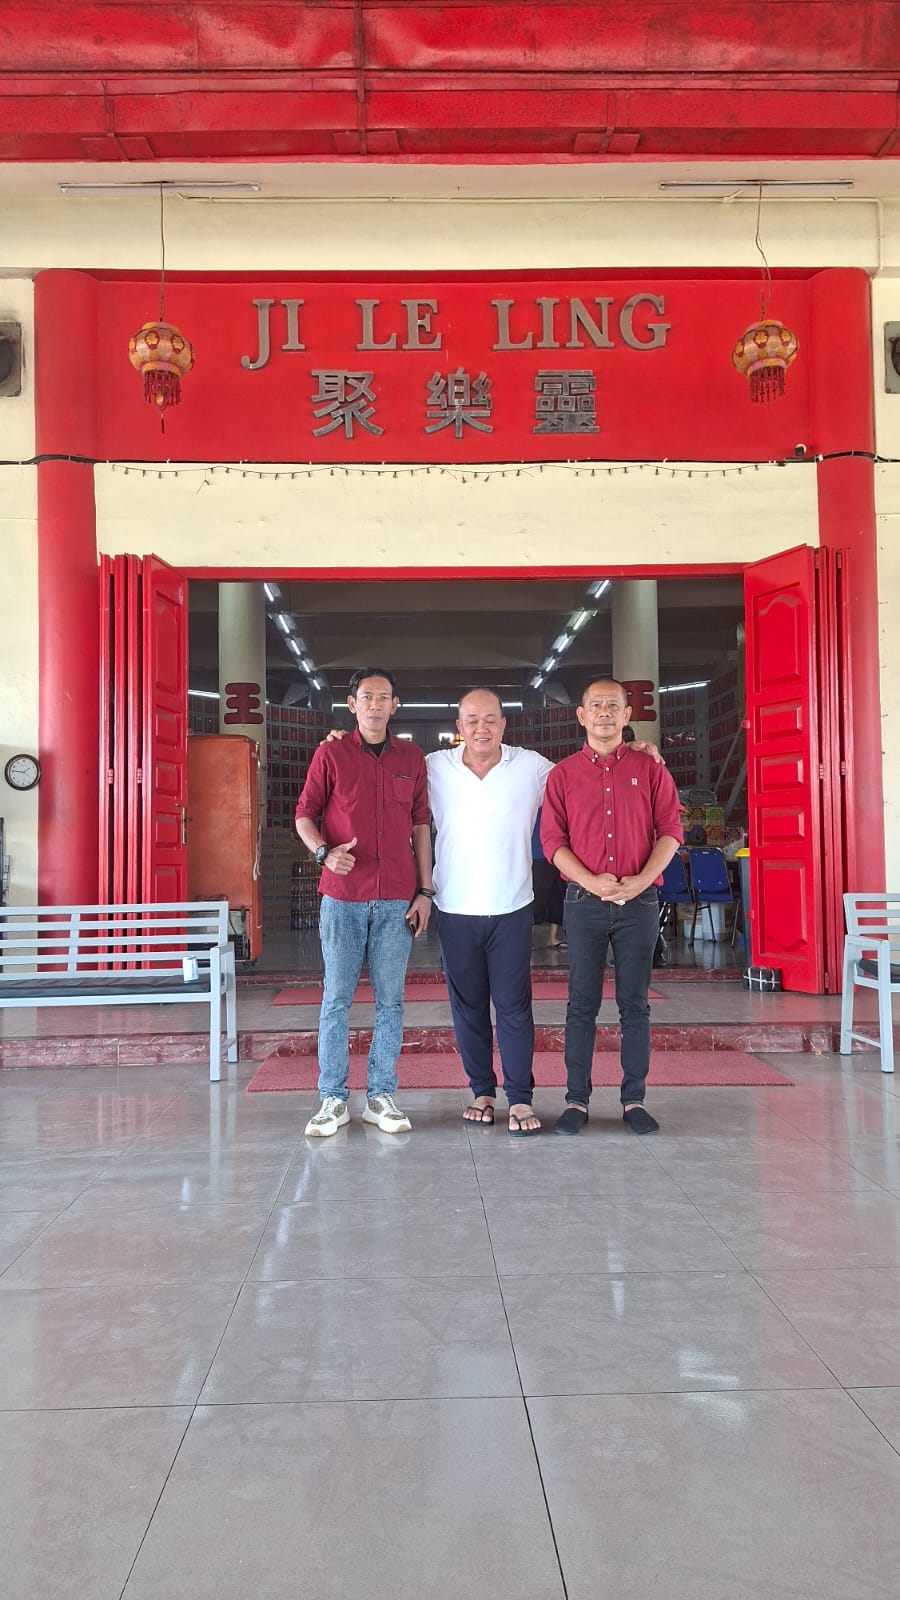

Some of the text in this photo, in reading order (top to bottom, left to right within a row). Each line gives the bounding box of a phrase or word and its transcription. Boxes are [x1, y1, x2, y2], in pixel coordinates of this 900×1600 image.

[240, 293, 672, 370] JI LE LING
[311, 366, 600, 439] 聚樂靈
